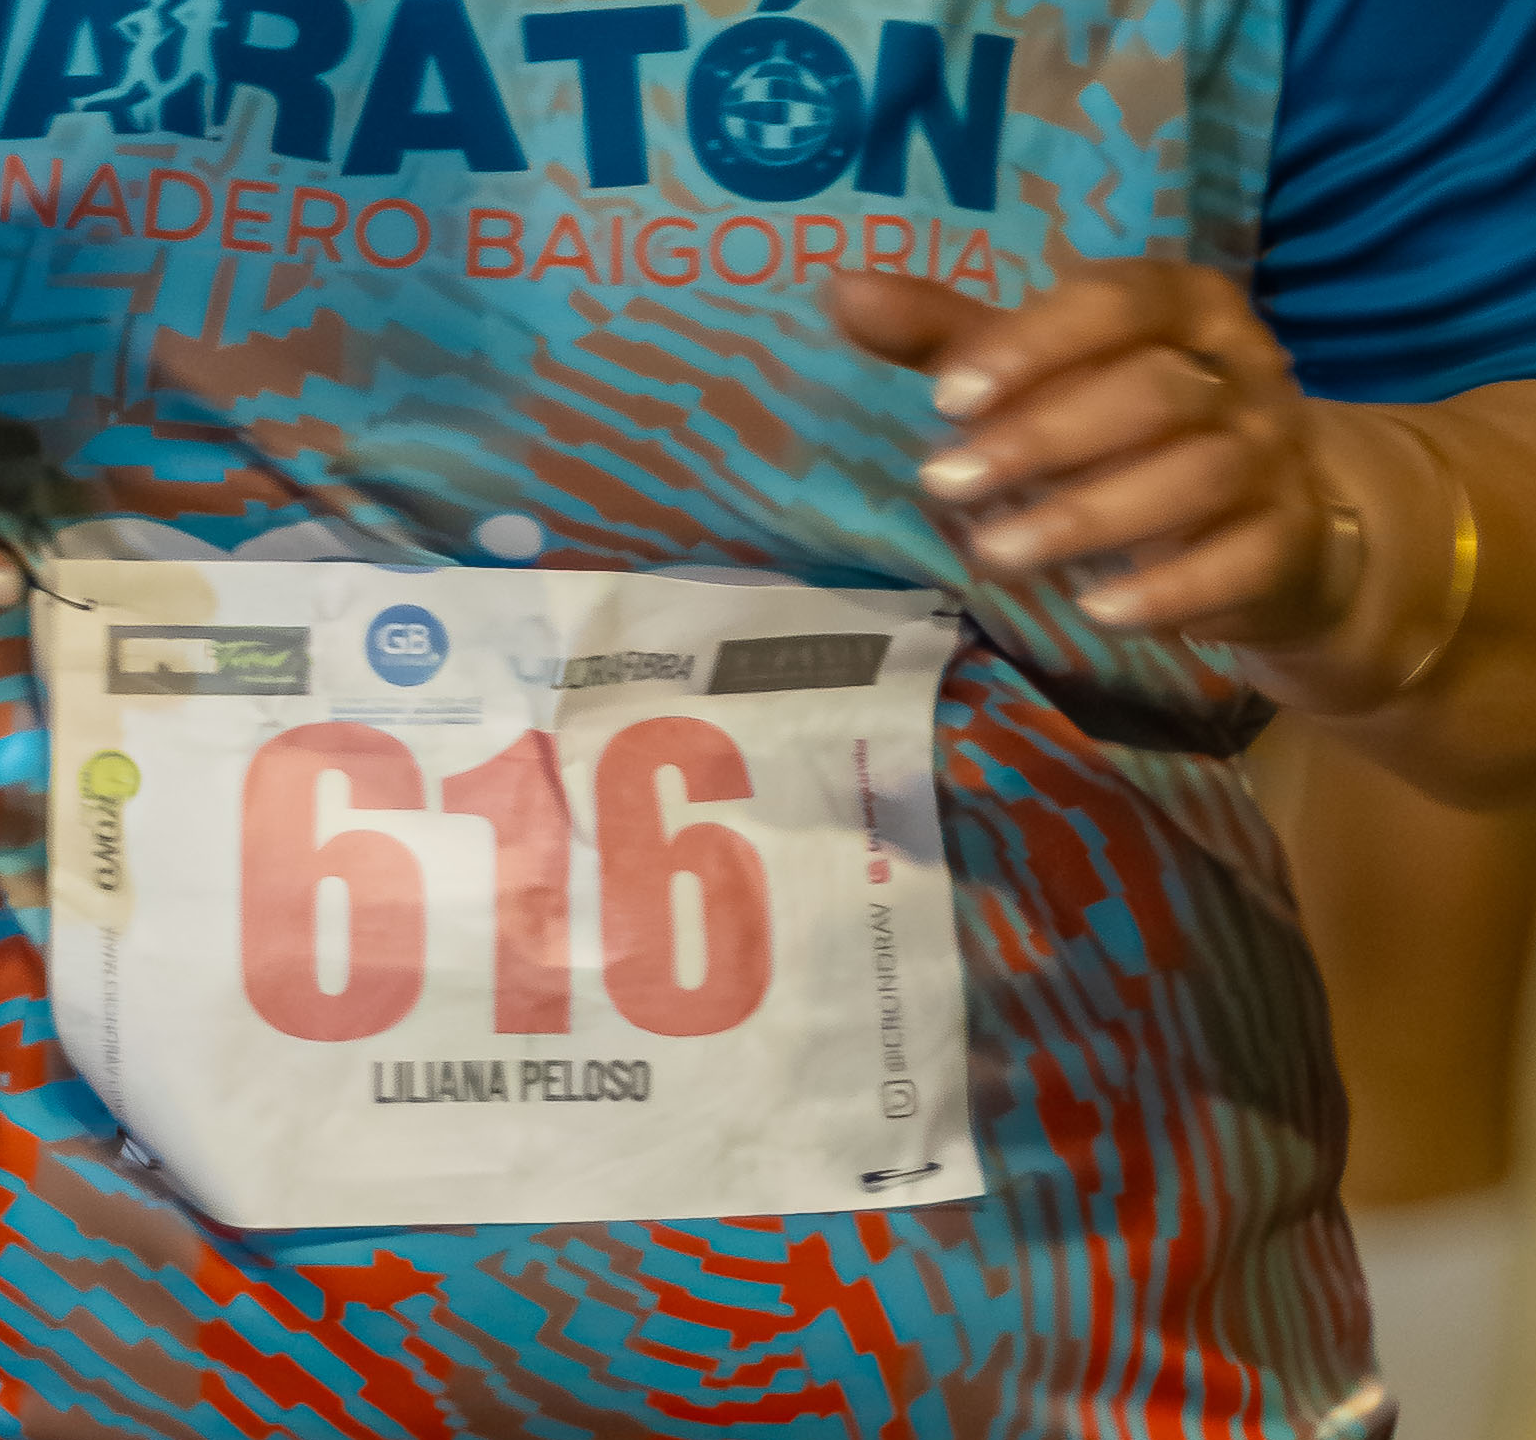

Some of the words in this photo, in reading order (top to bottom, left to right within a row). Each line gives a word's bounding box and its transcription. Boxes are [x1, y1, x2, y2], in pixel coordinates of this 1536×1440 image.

[467, 210, 1001, 302] BAIGORRIA
[240, 715, 774, 1043] 616
[372, 1059, 511, 1103] LILIANA
[519, 1059, 653, 1102] PELOSO
